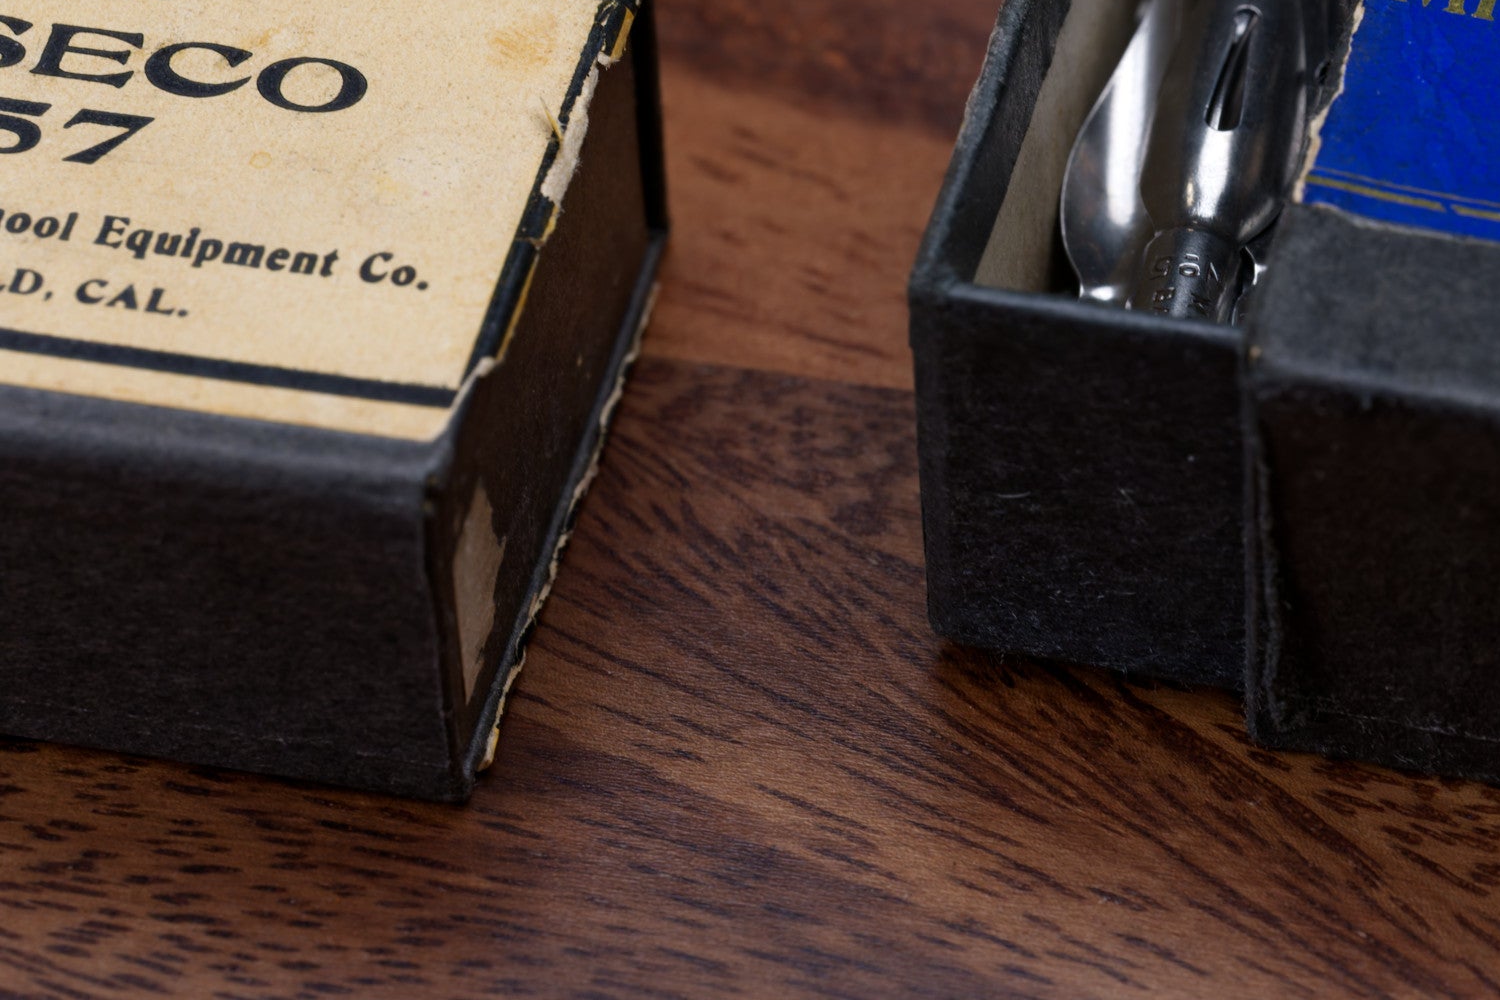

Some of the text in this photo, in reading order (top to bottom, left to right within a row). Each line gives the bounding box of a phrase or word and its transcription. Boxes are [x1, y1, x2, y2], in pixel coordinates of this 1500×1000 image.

[94, 214, 338, 279] Equipment
[357, 251, 430, 292] Co.
[75, 278, 189, 318] CAL.
